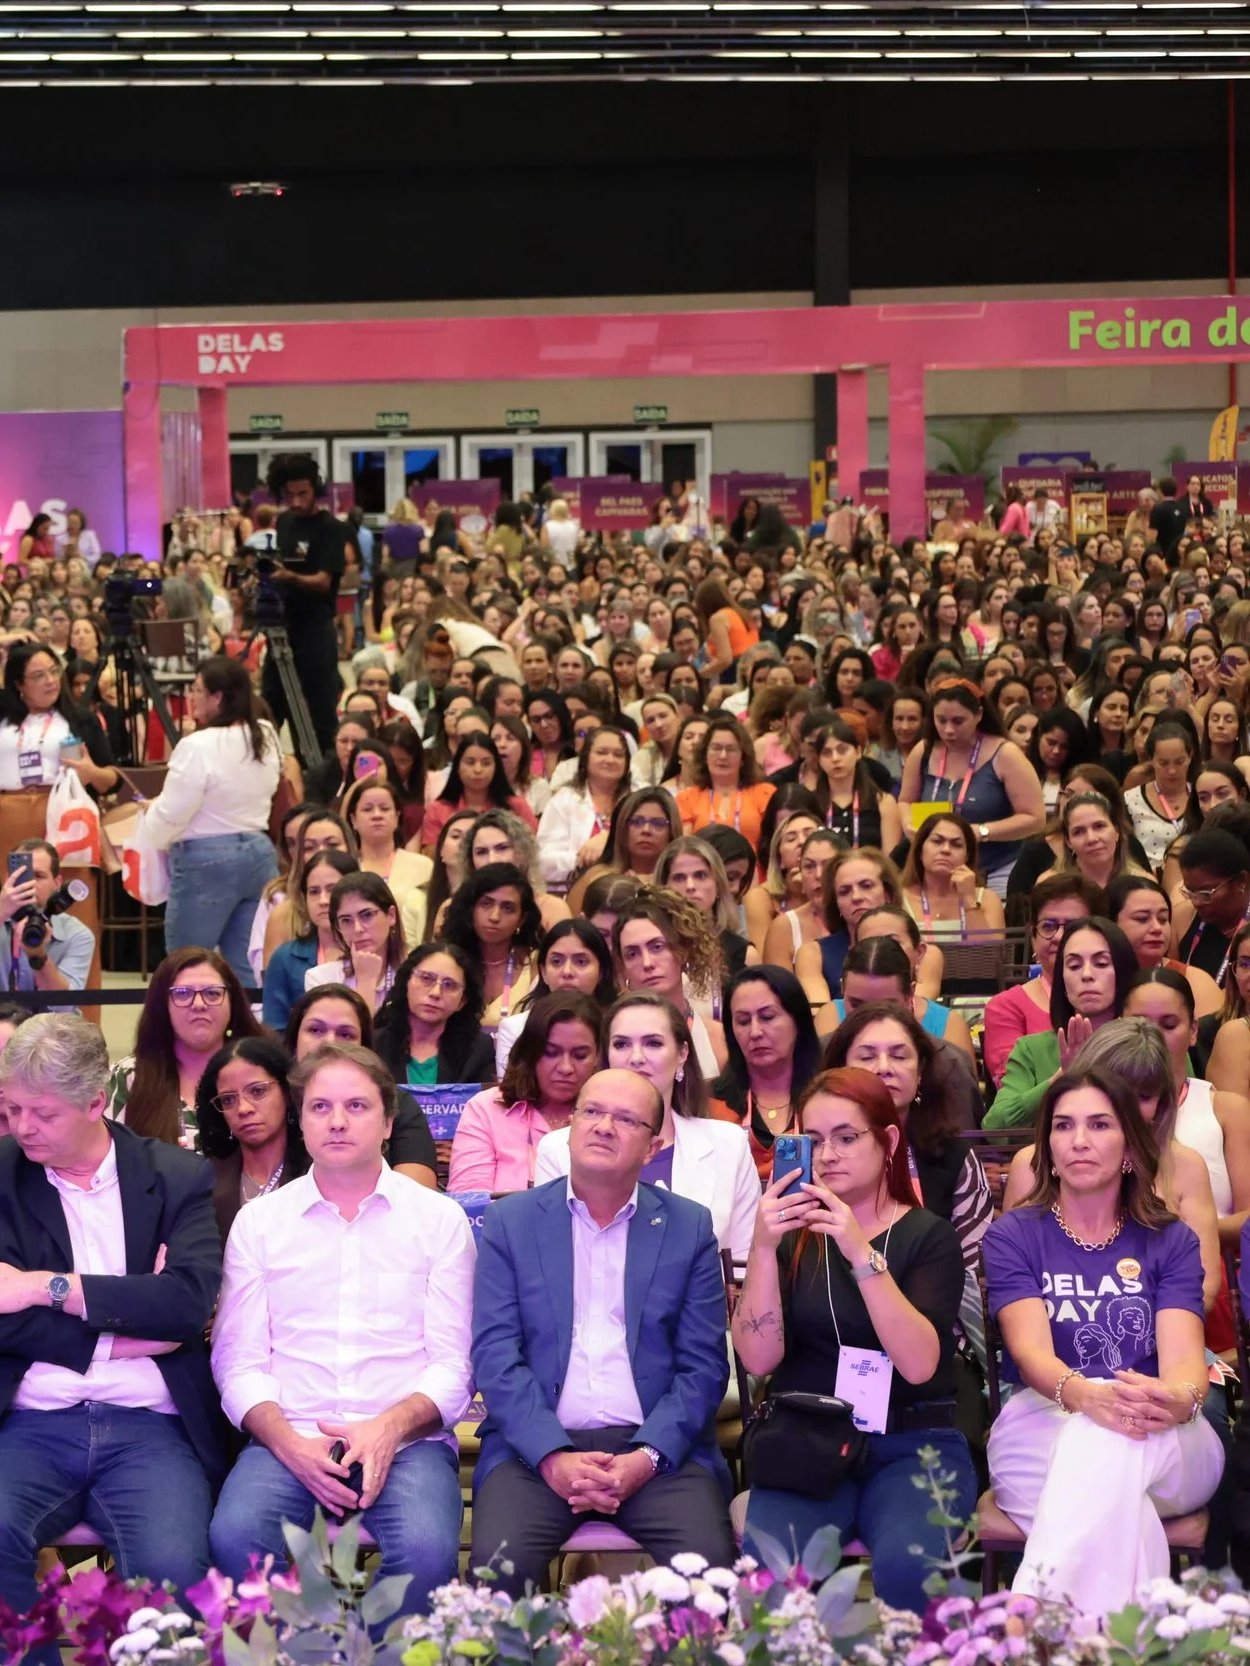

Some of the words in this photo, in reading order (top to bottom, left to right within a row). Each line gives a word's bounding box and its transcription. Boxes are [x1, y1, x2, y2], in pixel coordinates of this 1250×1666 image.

[1069, 307, 1191, 350] Feira
[197, 332, 285, 353] DELAS
[197, 354, 252, 374] DAY
[422, 1104, 465, 1115] SERVAD
[850, 1363, 880, 1374] SEBRAE
